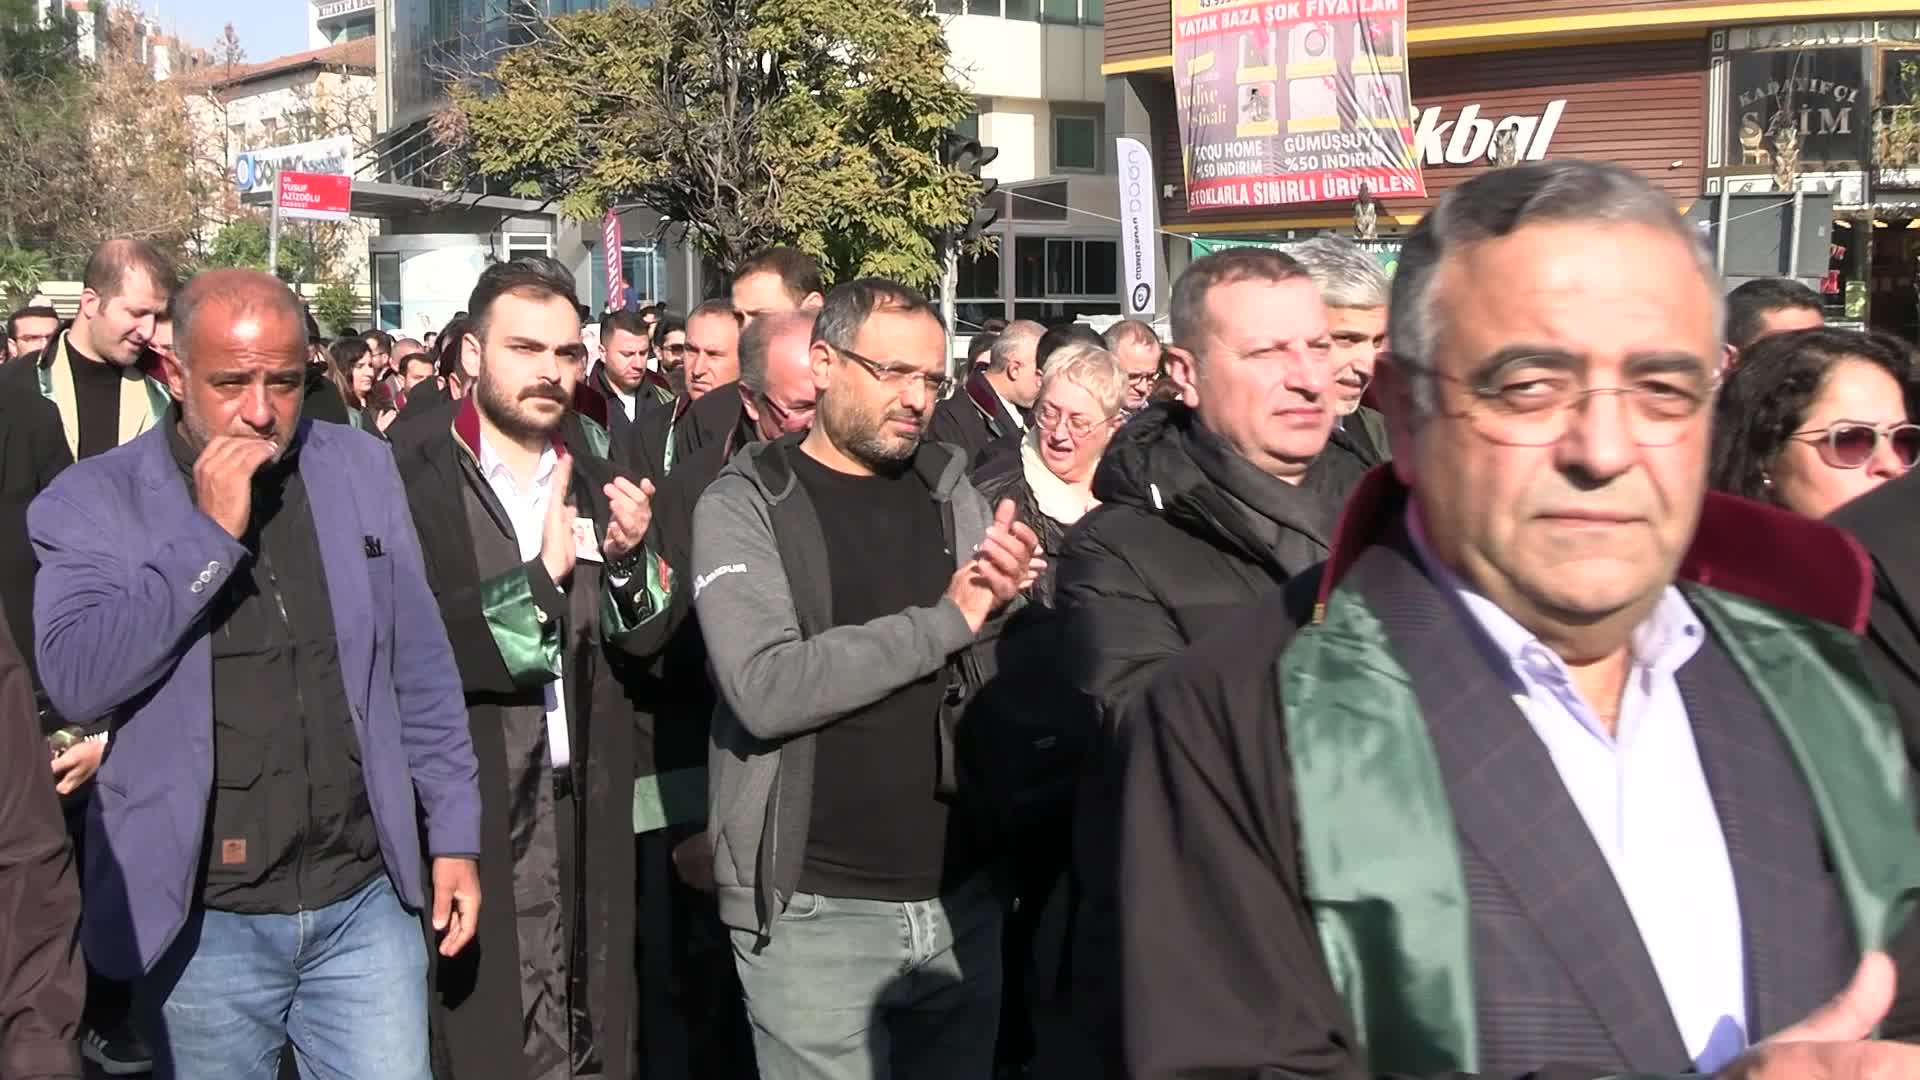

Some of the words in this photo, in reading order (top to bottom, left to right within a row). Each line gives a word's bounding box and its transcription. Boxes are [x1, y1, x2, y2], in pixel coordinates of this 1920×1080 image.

[1178, 15, 1218, 37] YATAK
[1221, 8, 1260, 29] BAZA
[1264, 2, 1300, 26] ŞOK
[1225, 140, 1263, 159] HOME
[1286, 155, 1319, 171] %50
[282, 183, 308, 193] YUSUF
[1190, 184, 1249, 206] STOKLARLA
[1253, 179, 1317, 205] SINIRLI
